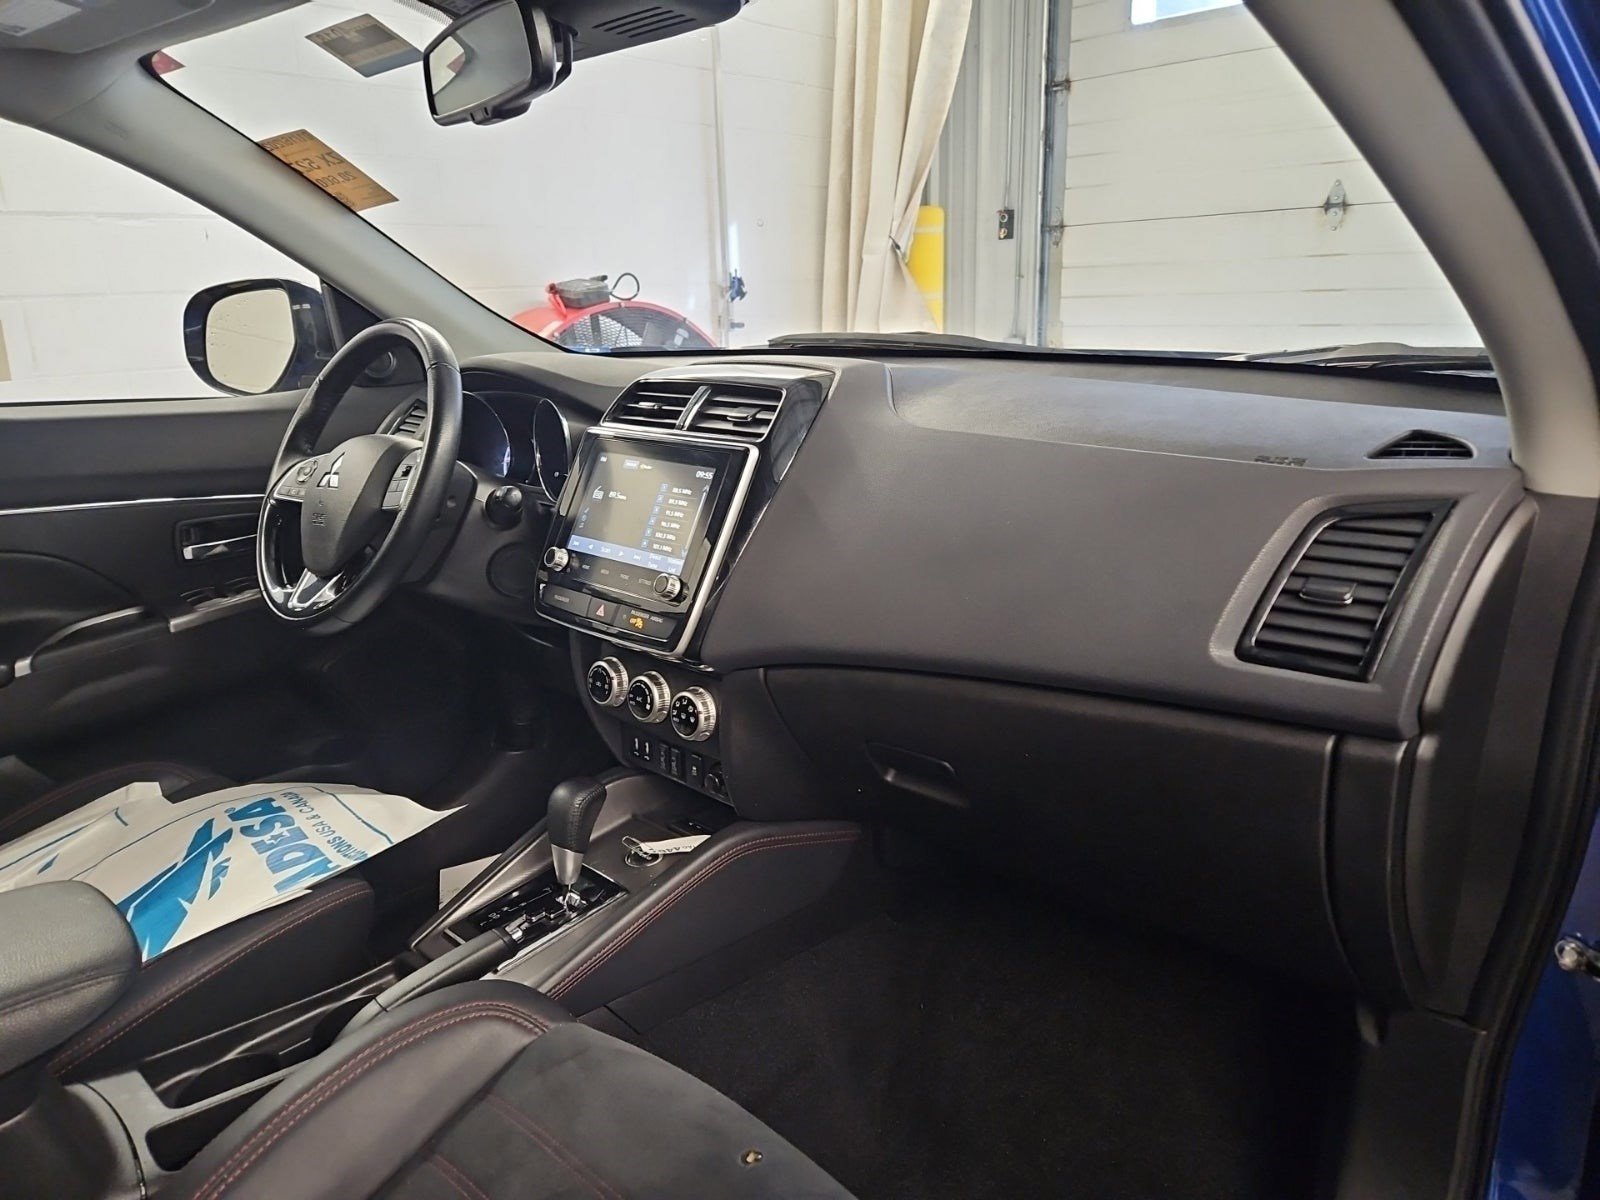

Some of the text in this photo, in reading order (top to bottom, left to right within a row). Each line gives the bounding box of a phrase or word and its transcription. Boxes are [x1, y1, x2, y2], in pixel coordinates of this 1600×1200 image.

[695, 470, 714, 480] 09:55
[305, 813, 320, 821] &
[312, 821, 336, 838] USA
[227, 797, 342, 893] ADESA
